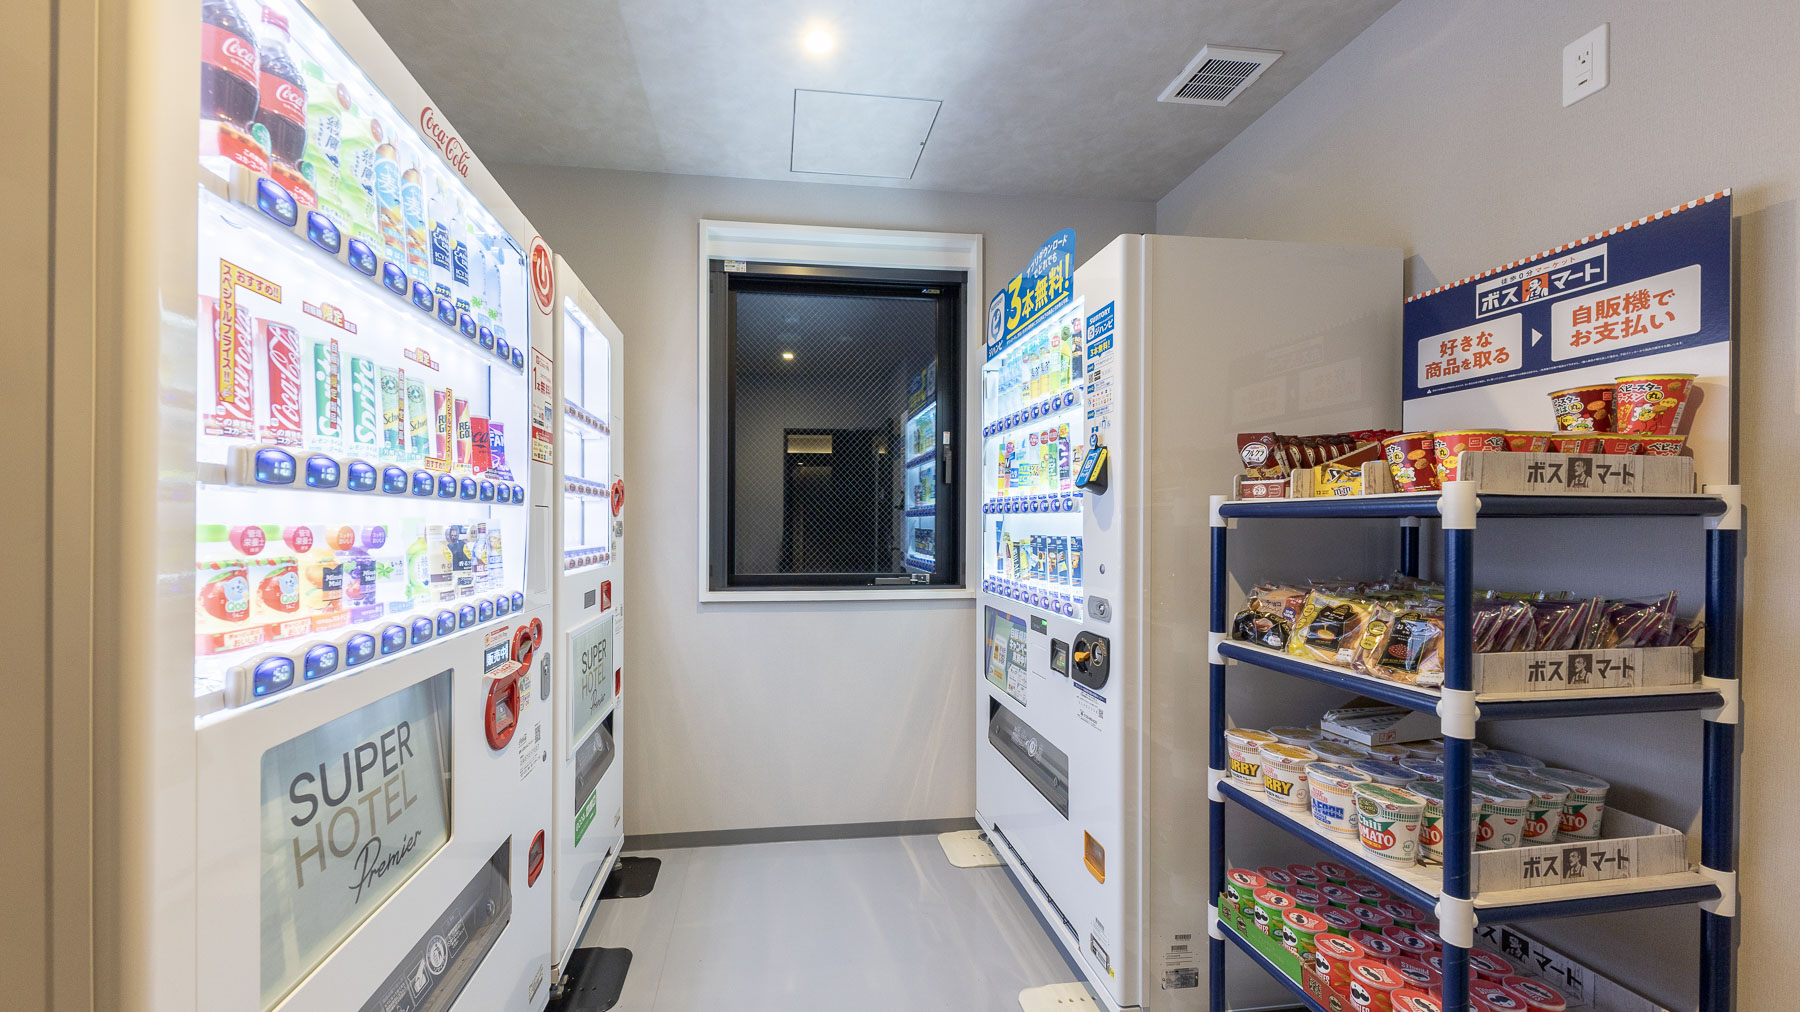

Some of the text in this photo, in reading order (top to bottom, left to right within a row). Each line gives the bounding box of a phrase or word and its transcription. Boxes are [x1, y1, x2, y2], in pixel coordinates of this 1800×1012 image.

[420, 106, 470, 179] Coca-Cola
[1481, 264, 1601, 313] ボス マート
[1089, 307, 1111, 325] SUNTORY
[1571, 288, 1677, 328] 自販機で
[1439, 331, 1494, 359] 好きな
[1569, 310, 1676, 348] お支払い
[1425, 347, 1511, 380] 商品を取る
[355, 359, 376, 443] Sprite
[1527, 461, 1636, 485] ボス マート
[226, 601, 248, 612] Qoo
[280, 593, 298, 605] Qoo
[486, 642, 509, 668] 販売中
[582, 639, 607, 675] SUPER
[1528, 657, 1634, 683] ボス マート
[582, 663, 606, 702] HOTEL
[290, 720, 414, 828] SUPER
[293, 769, 418, 889] HOTEL
[349, 828, 422, 905] Premier
[1523, 848, 1631, 879] ボス マート
[1532, 950, 1583, 988] マート
